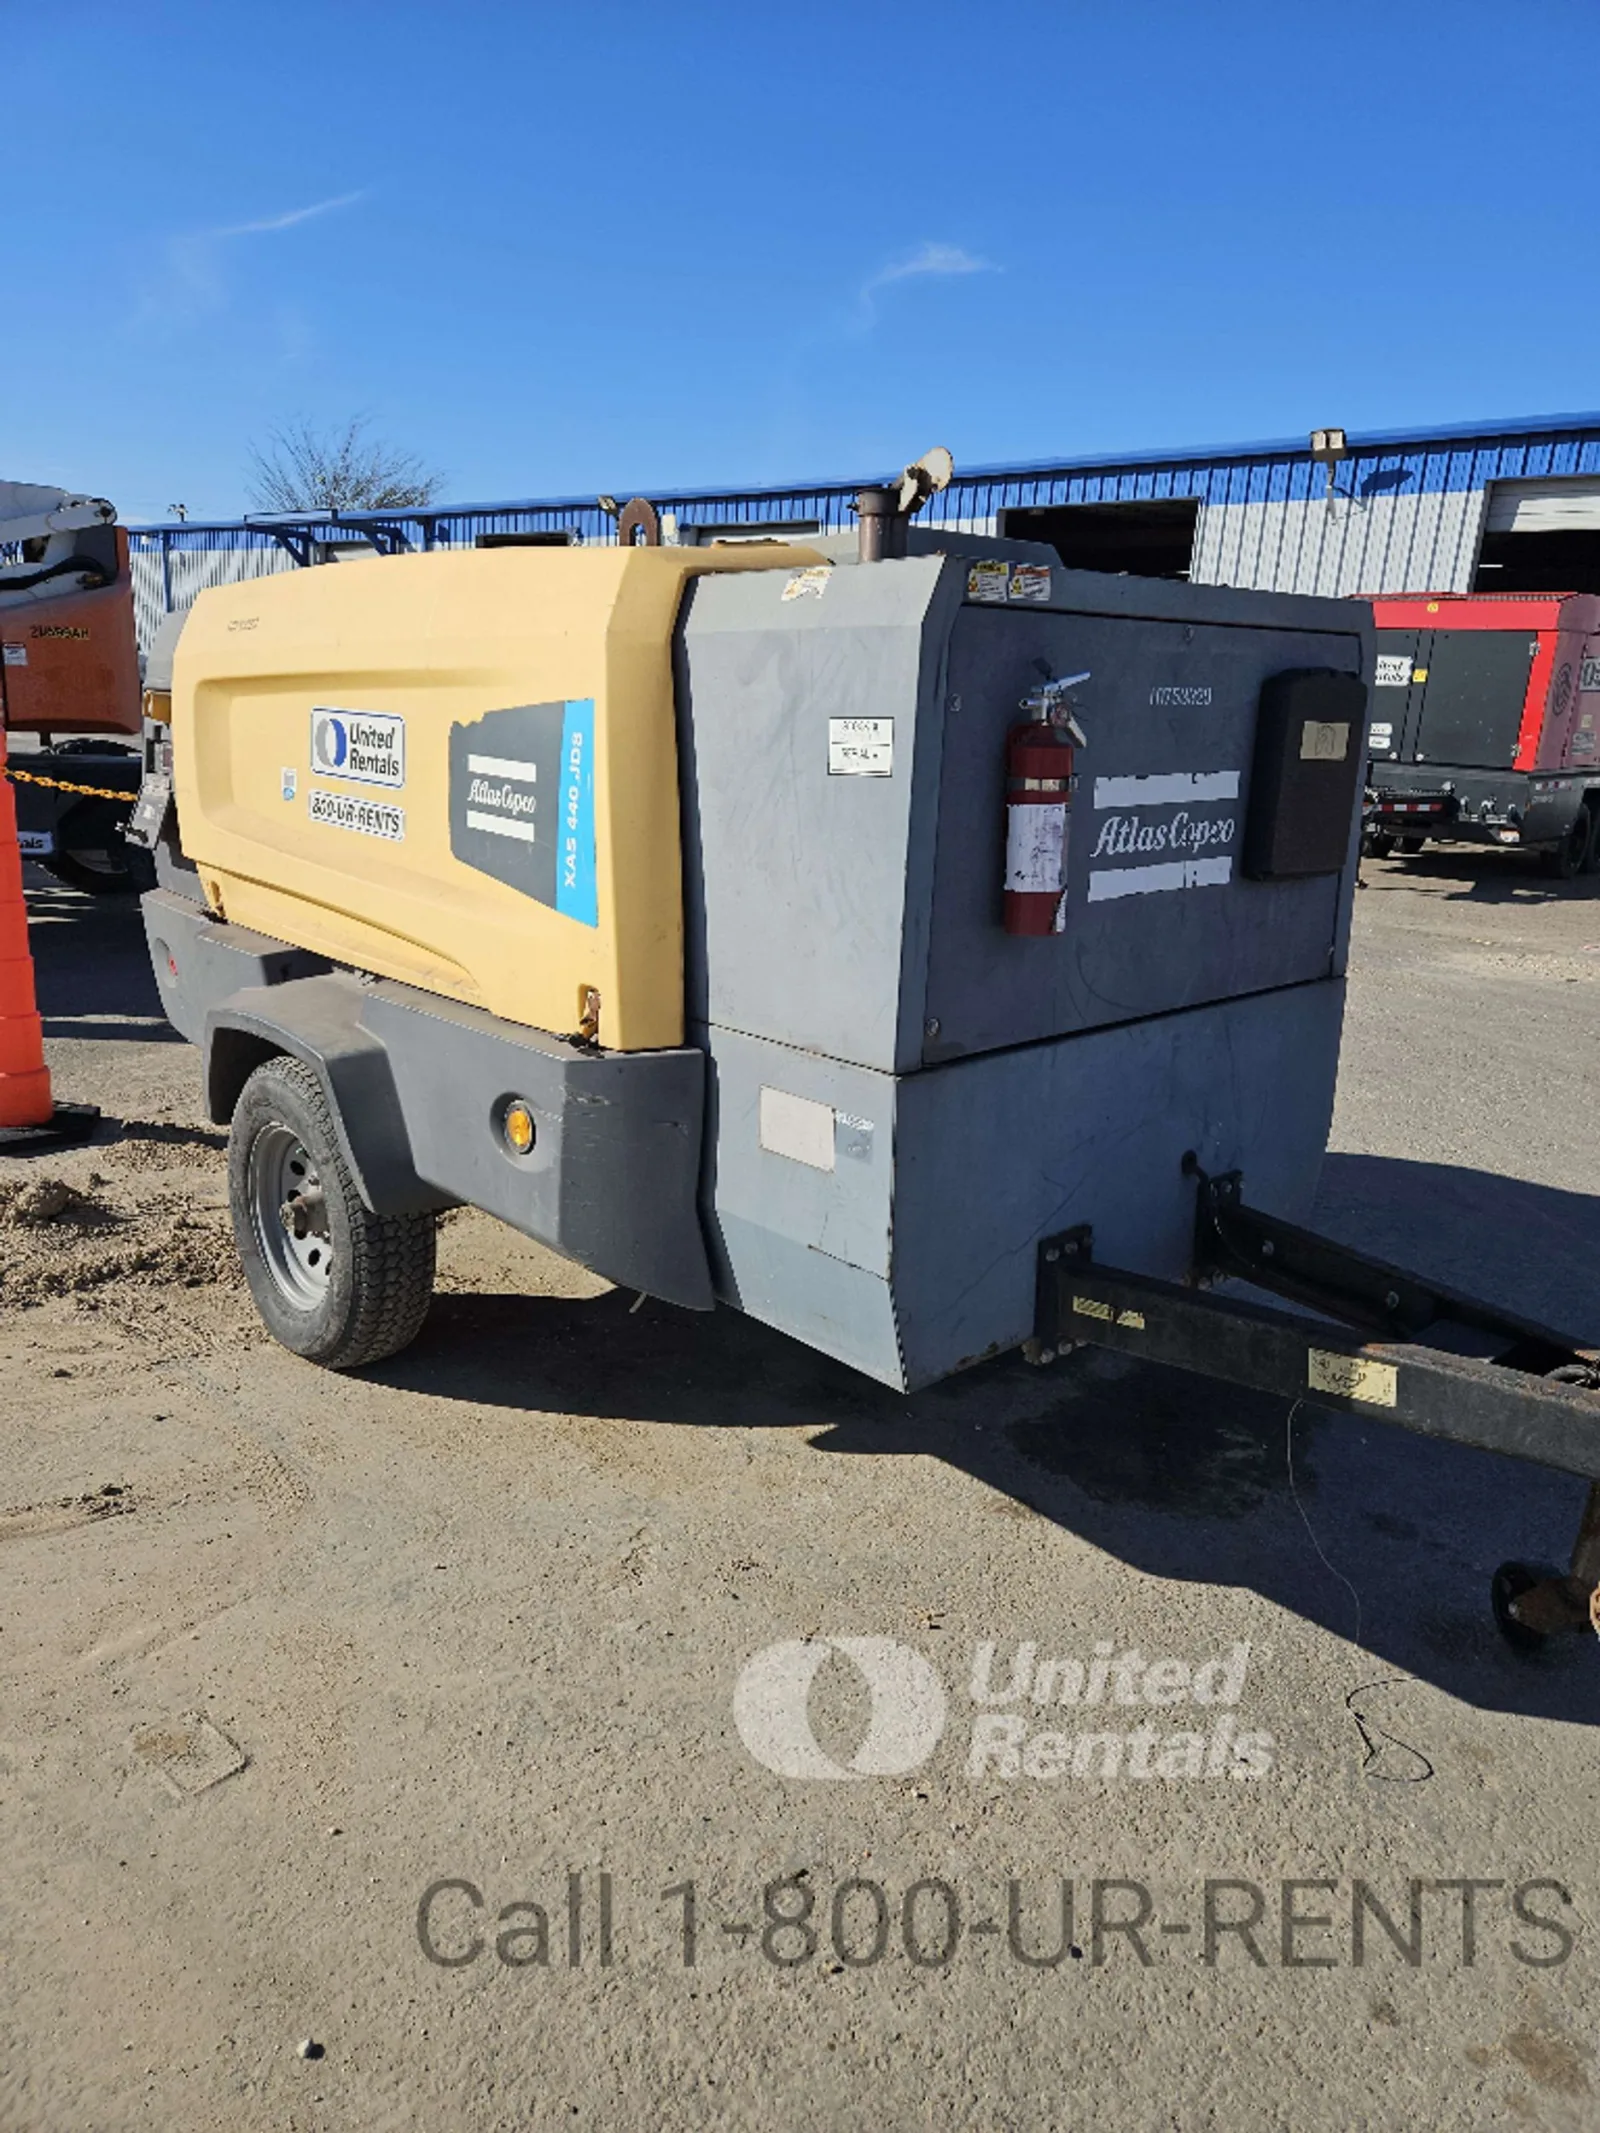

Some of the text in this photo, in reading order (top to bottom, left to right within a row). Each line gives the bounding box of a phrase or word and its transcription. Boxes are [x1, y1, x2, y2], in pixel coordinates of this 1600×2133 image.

[349, 722, 396, 750] United
[349, 747, 400, 777] Rentals
[312, 797, 401, 833] 800-UR-RENTS
[566, 788, 580, 832] 440
[1090, 816, 1168, 858] Atlas
[1168, 811, 1236, 854] Copco
[564, 838, 578, 888] XAS
